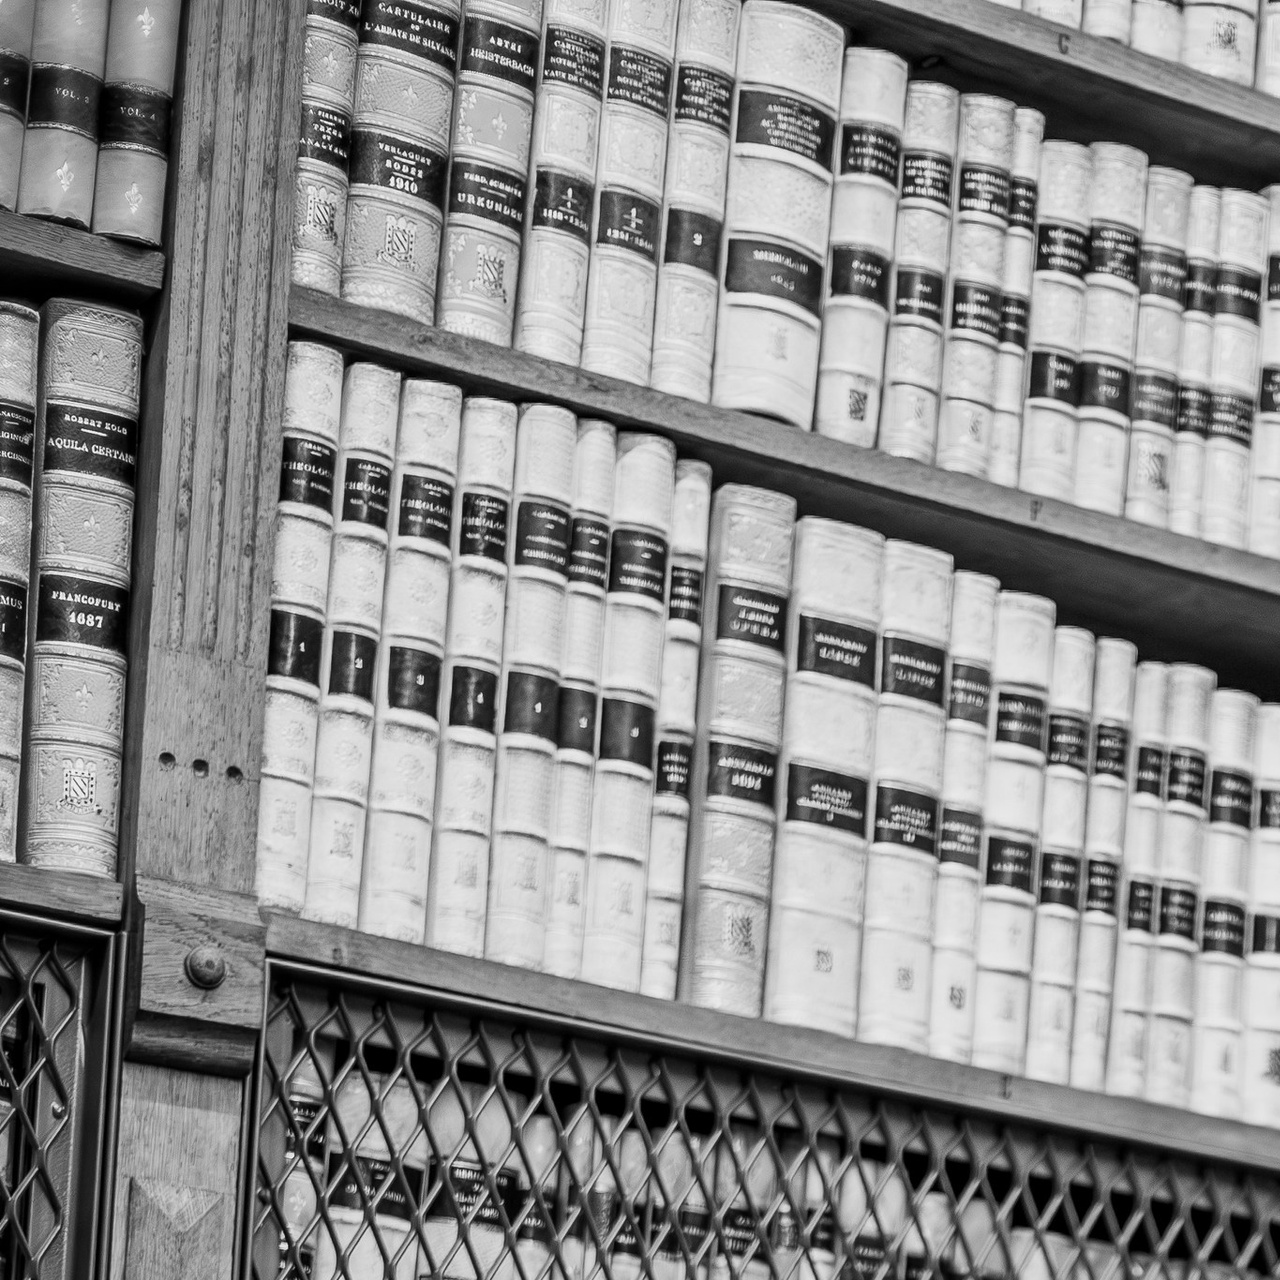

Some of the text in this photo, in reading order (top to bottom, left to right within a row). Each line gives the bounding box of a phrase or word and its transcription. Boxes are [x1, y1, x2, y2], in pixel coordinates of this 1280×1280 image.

[378, 2, 451, 34] CARTULAIRE
[55, 86, 80, 101] VOL.
[120, 106, 146, 119] VOL.
[389, 175, 419, 194] 1910
[64, 412, 103, 429] ROBERT
[47, 436, 89, 453] AQUILA
[51, 590, 121, 612] FRANCOFURT
[69, 611, 104, 629] 1687
